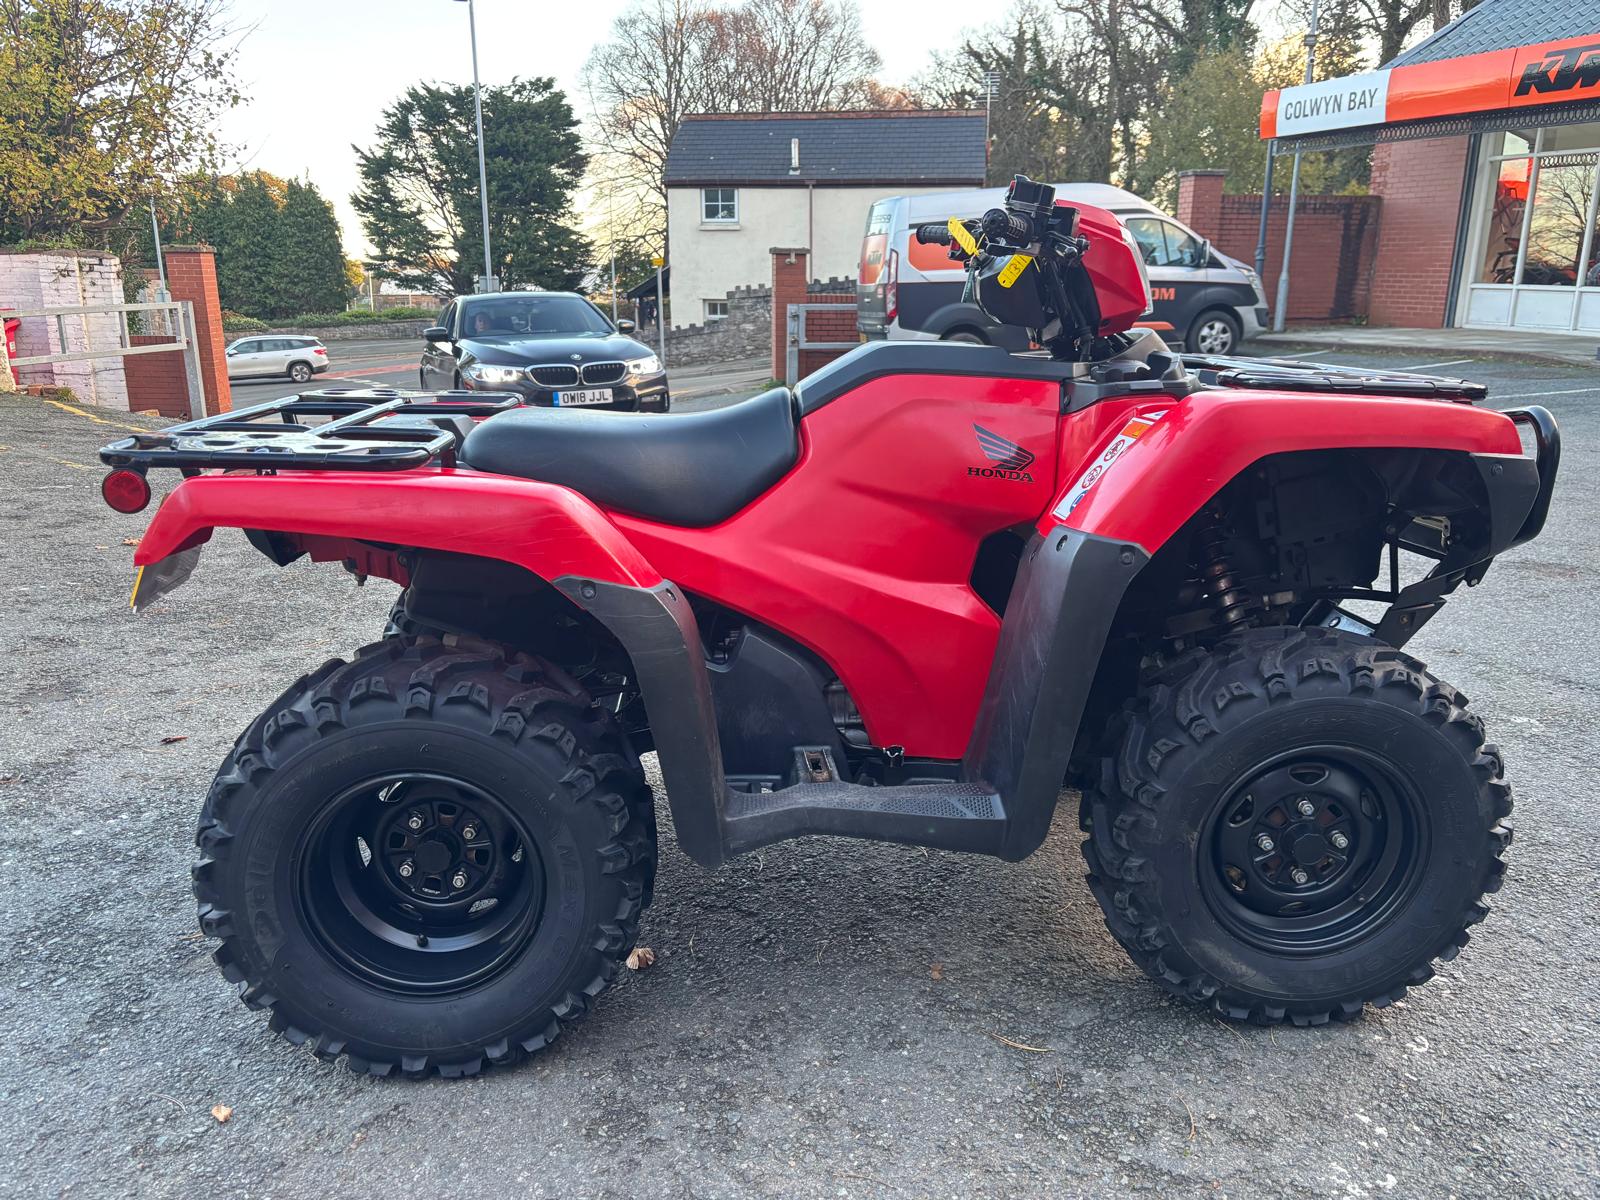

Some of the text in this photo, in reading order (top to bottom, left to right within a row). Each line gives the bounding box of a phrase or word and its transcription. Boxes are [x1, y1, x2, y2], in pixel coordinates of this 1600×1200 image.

[1284, 88, 1378, 121] COLWYN BAY
[562, 390, 609, 404] OW18 JJL
[967, 466, 1034, 483] HONDA
